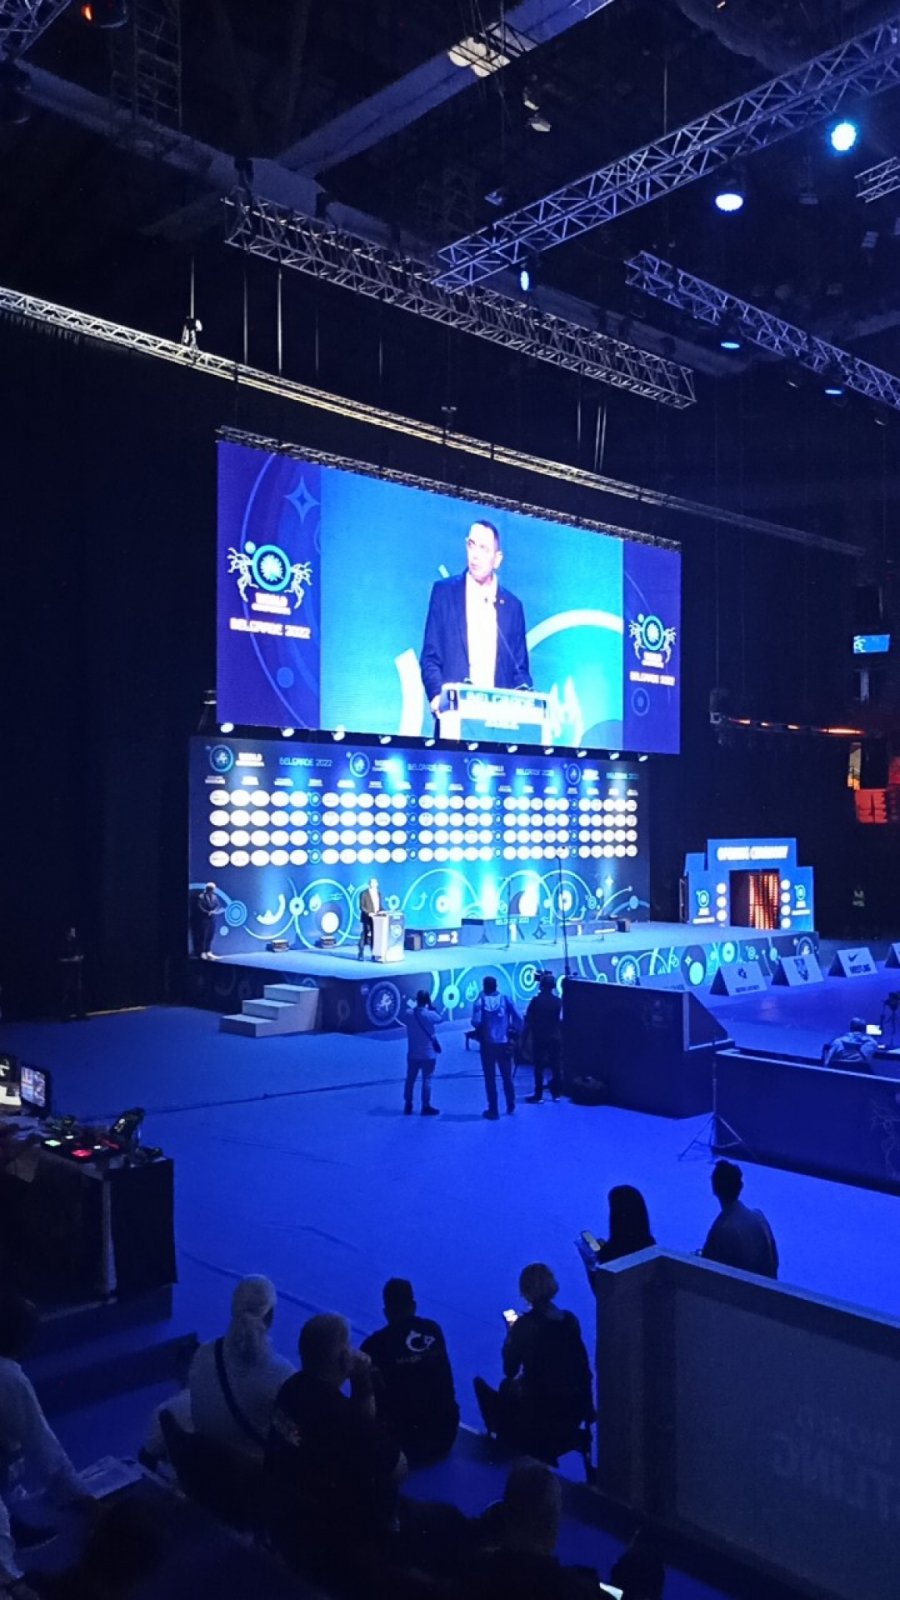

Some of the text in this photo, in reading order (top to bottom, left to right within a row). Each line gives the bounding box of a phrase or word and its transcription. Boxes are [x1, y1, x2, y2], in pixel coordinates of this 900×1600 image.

[284, 624, 311, 639] 2022
[279, 757, 332, 767] BELGRADE 2022
